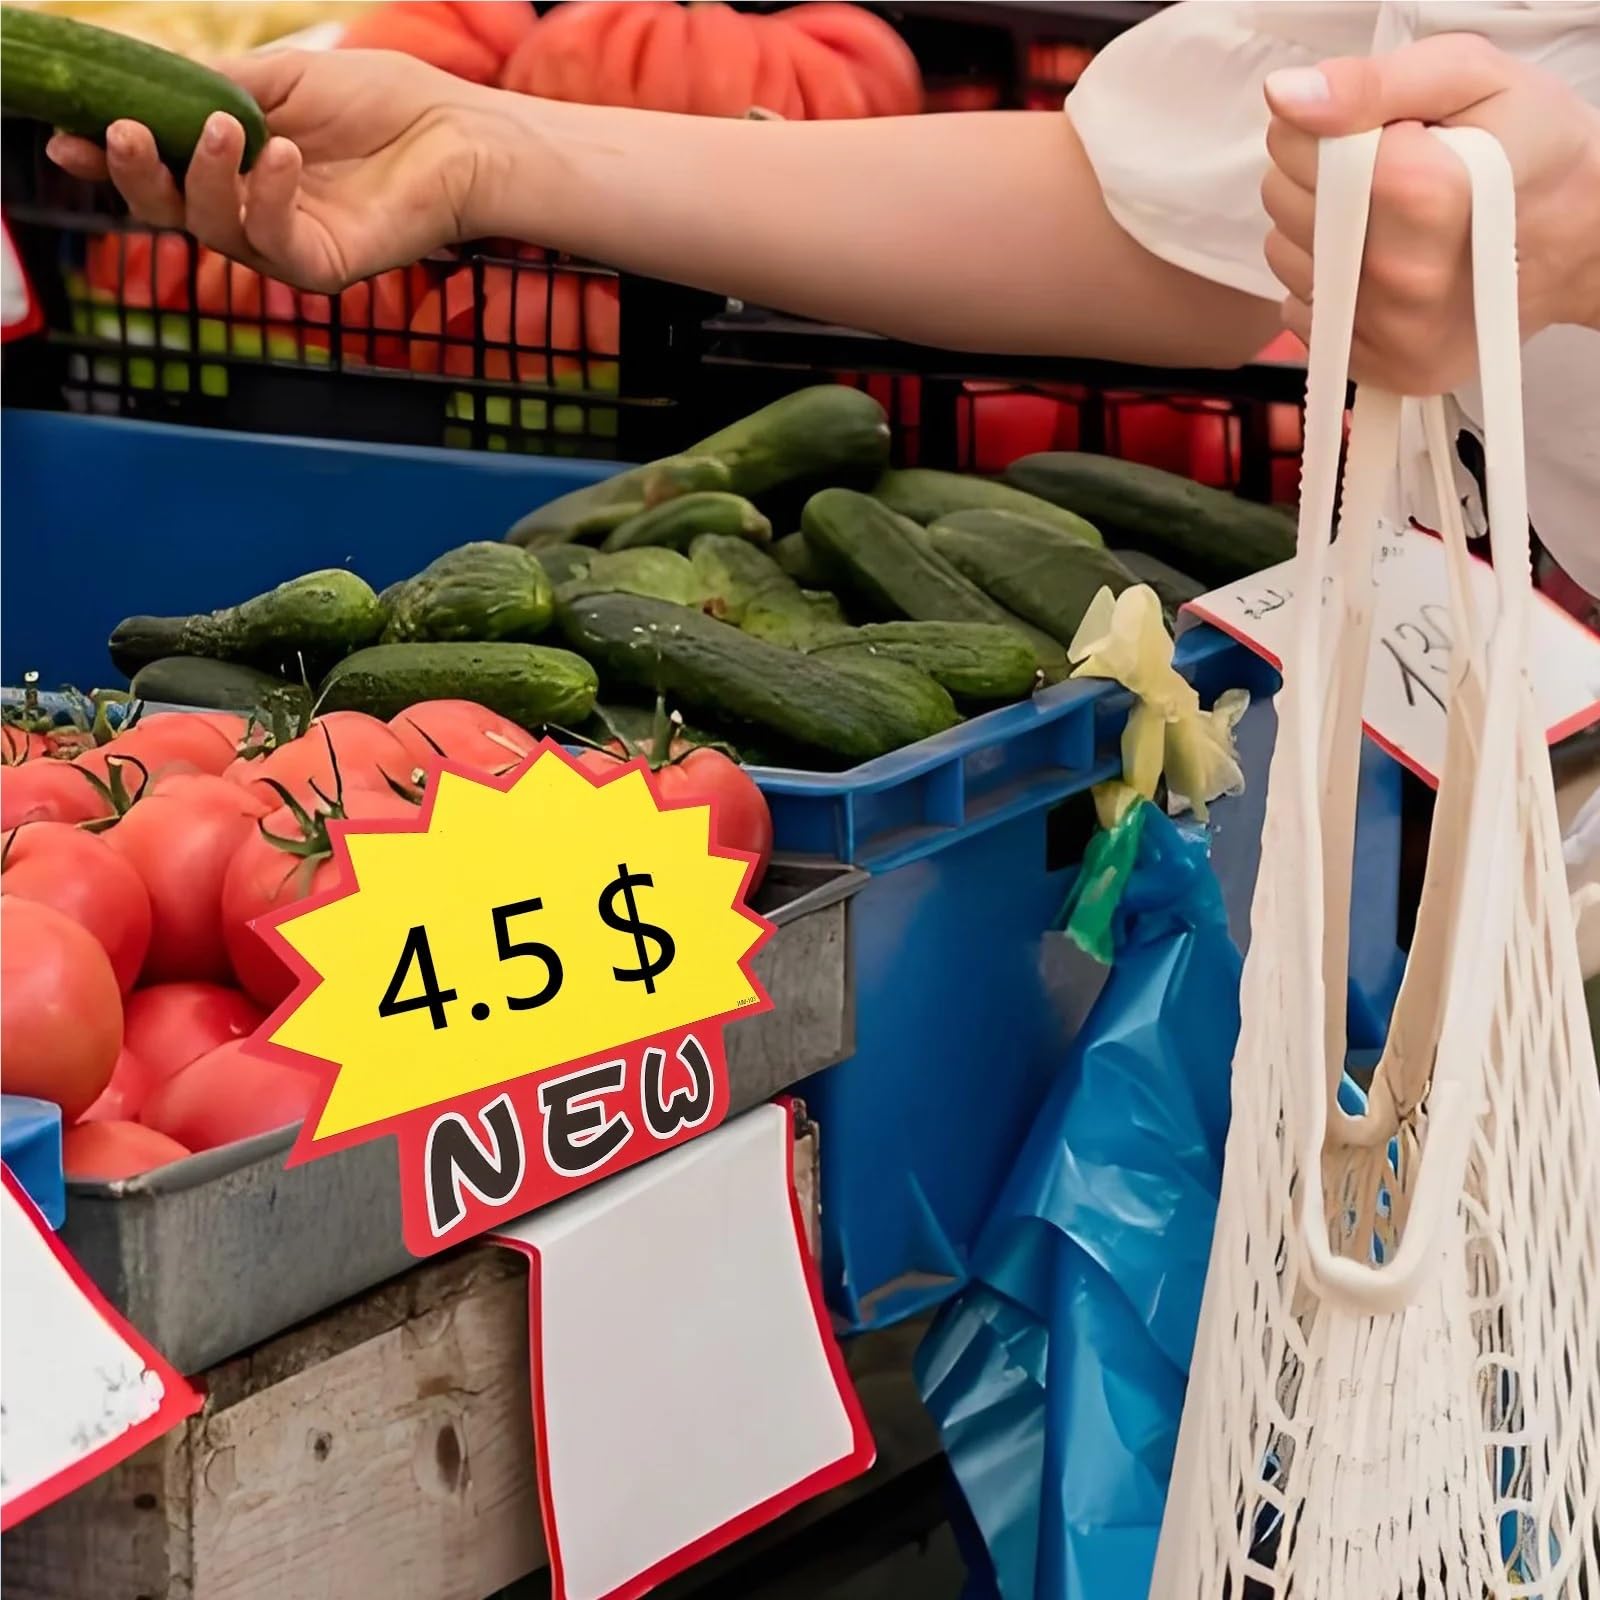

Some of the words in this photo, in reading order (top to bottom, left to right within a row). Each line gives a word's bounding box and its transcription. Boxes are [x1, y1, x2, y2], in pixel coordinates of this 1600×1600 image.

[378, 897, 564, 1030] 4.5
[598, 863, 676, 995] $
[425, 1034, 714, 1238] NEW
